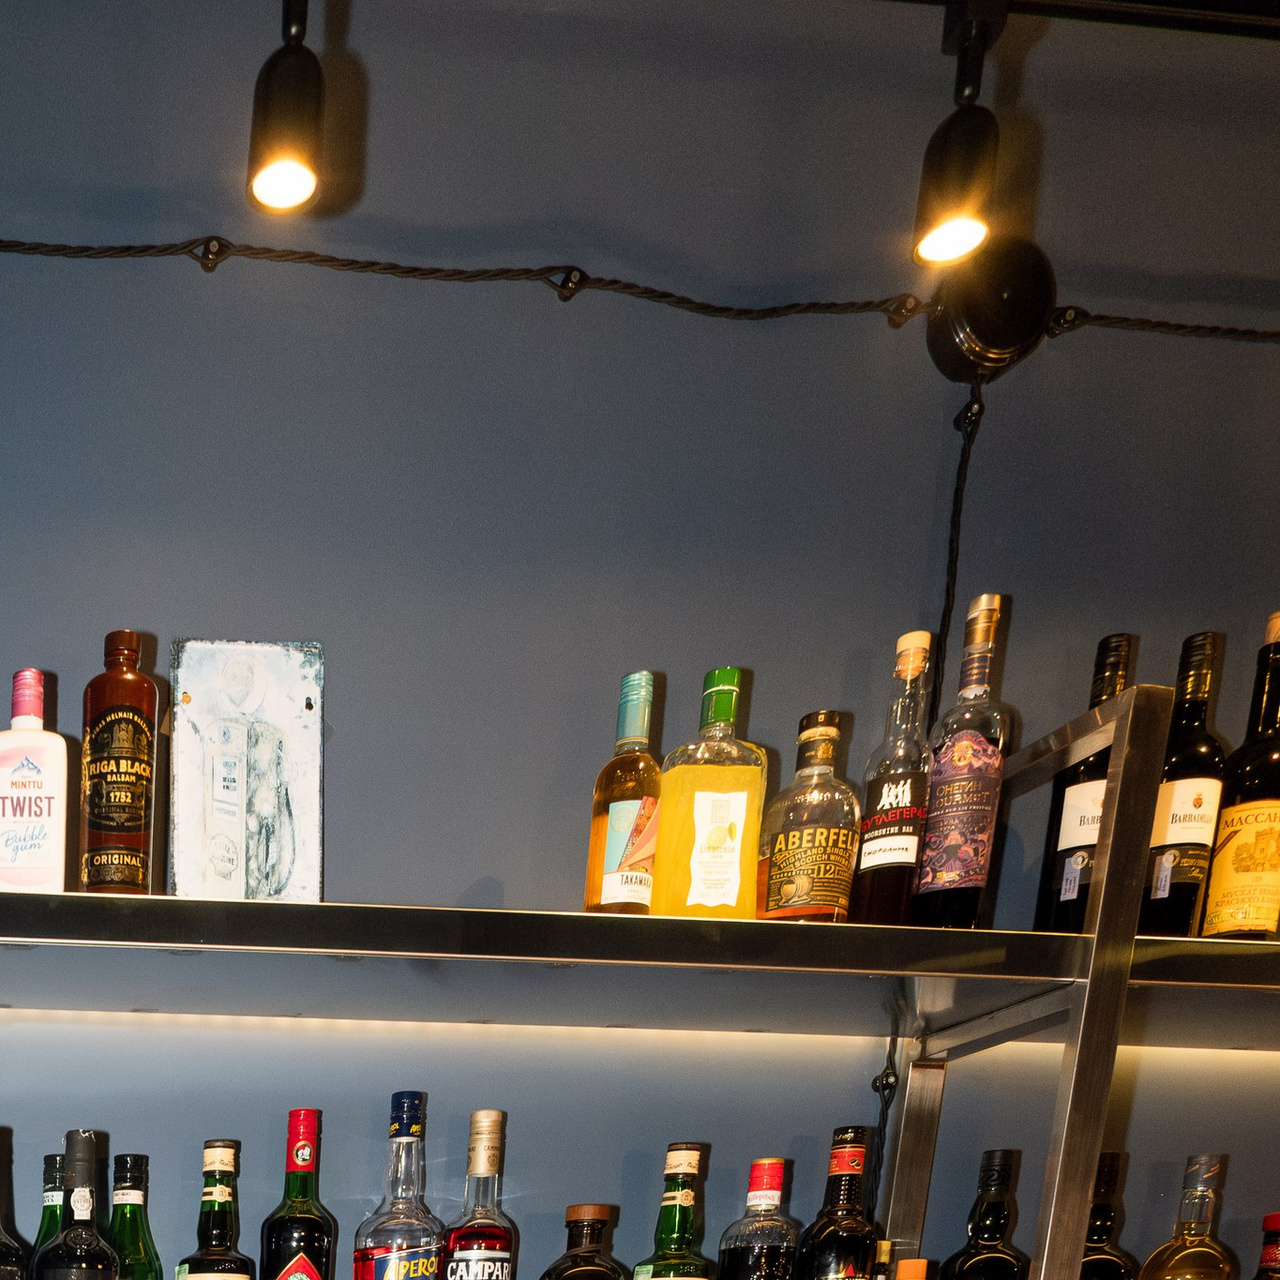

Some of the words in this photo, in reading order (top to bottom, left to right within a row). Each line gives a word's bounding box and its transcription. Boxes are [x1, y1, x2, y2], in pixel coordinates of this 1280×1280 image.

[89, 760, 117, 775] RIGA
[119, 759, 152, 779] BLACK
[10, 780, 43, 790] MINTTU
[107, 774, 136, 783] BALSAM
[109, 791, 132, 803] 1752
[0, 824, 49, 848] Bubble
[11, 842, 43, 863] gum
[780, 847, 824, 869] HIGHLAND
[826, 847, 850, 860] SINGLE
[93, 854, 142, 867] ORIGINAL
[794, 853, 828, 868] SCOTCH
[817, 863, 835, 878] 12
